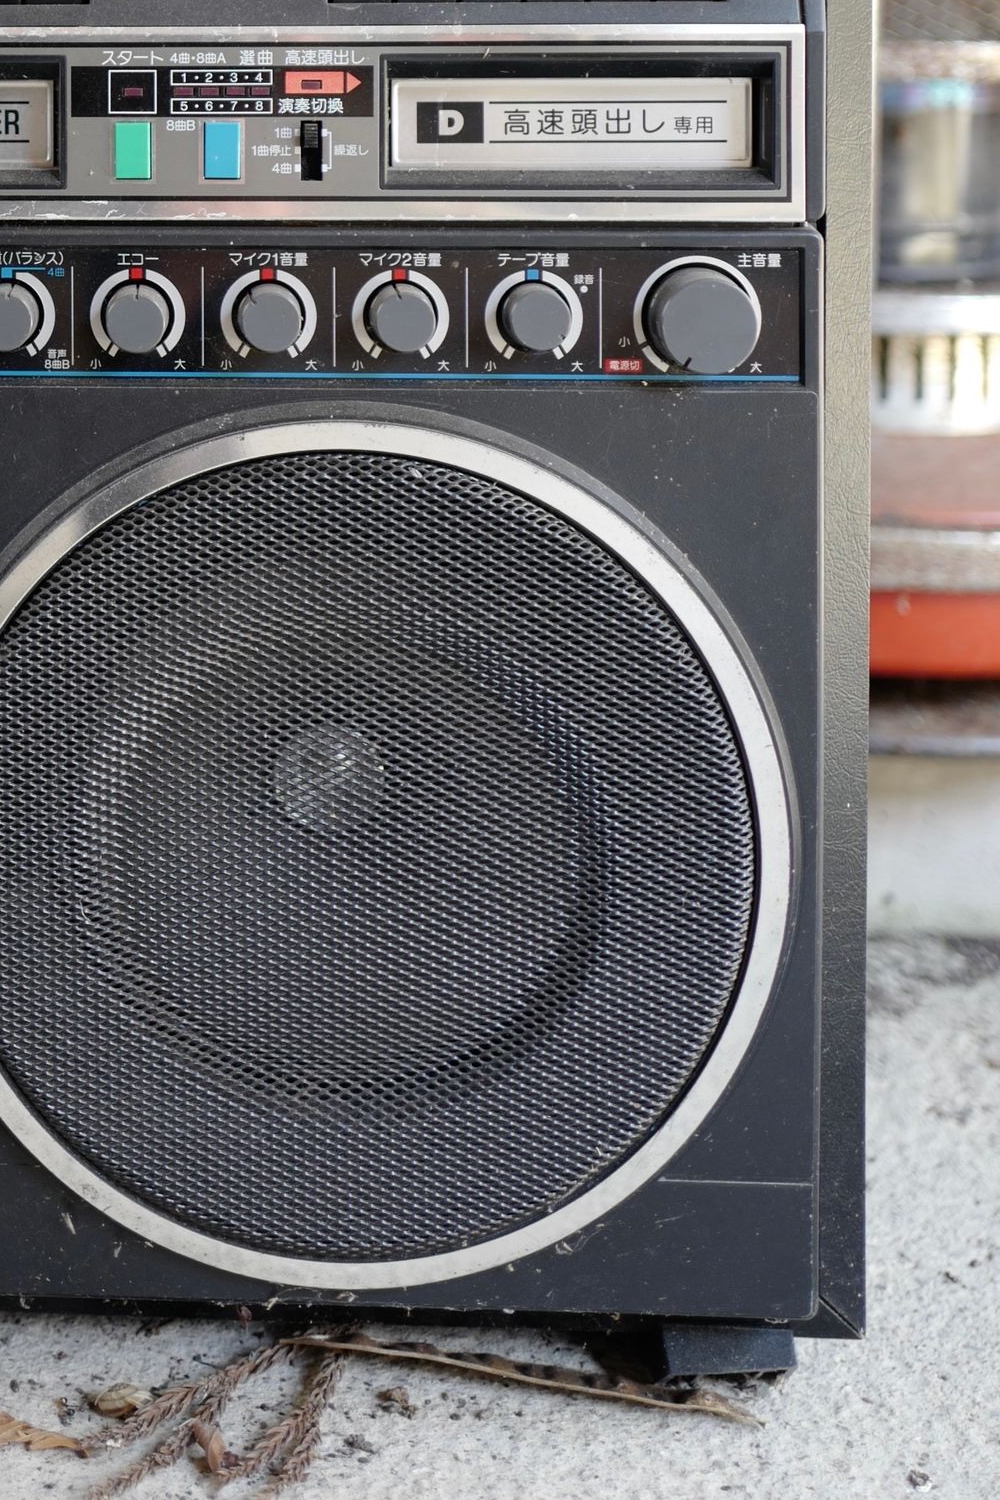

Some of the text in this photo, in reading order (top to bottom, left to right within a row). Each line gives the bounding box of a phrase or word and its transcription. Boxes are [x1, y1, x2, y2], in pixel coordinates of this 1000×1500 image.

[101, 50, 164, 66] スタート
[239, 50, 273, 66] 選曲
[285, 49, 365, 65] 高速頭出し
[278, 98, 344, 114] 演奏切換
[166, 120, 196, 131] 8曲B
[438, 109, 465, 136] D
[274, 128, 292, 138] 1曲
[251, 145, 292, 156] 1曲停止
[334, 145, 368, 156] 繰返し
[272, 163, 292, 174] 4曲
[117, 253, 159, 266] エコー
[228, 252, 309, 267] マイク1音量
[359, 252, 442, 267] マイク2音量
[498, 253, 570, 268] テープ音量
[737, 253, 782, 268] 主音量
[47, 268, 65, 277] 4曲
[574, 274, 595, 286] 録音
[619, 336, 631, 348] 小
[44, 359, 70, 369] 8曲B
[90, 359, 101, 369] 小
[174, 359, 186, 370] 大
[220, 359, 232, 370] 小
[305, 359, 317, 371] 大
[352, 359, 364, 370] 小
[438, 359, 450, 371] 大
[484, 360, 497, 372] 小
[571, 361, 583, 372] 大
[609, 360, 640, 372] 電源切
[750, 361, 762, 373] 大
